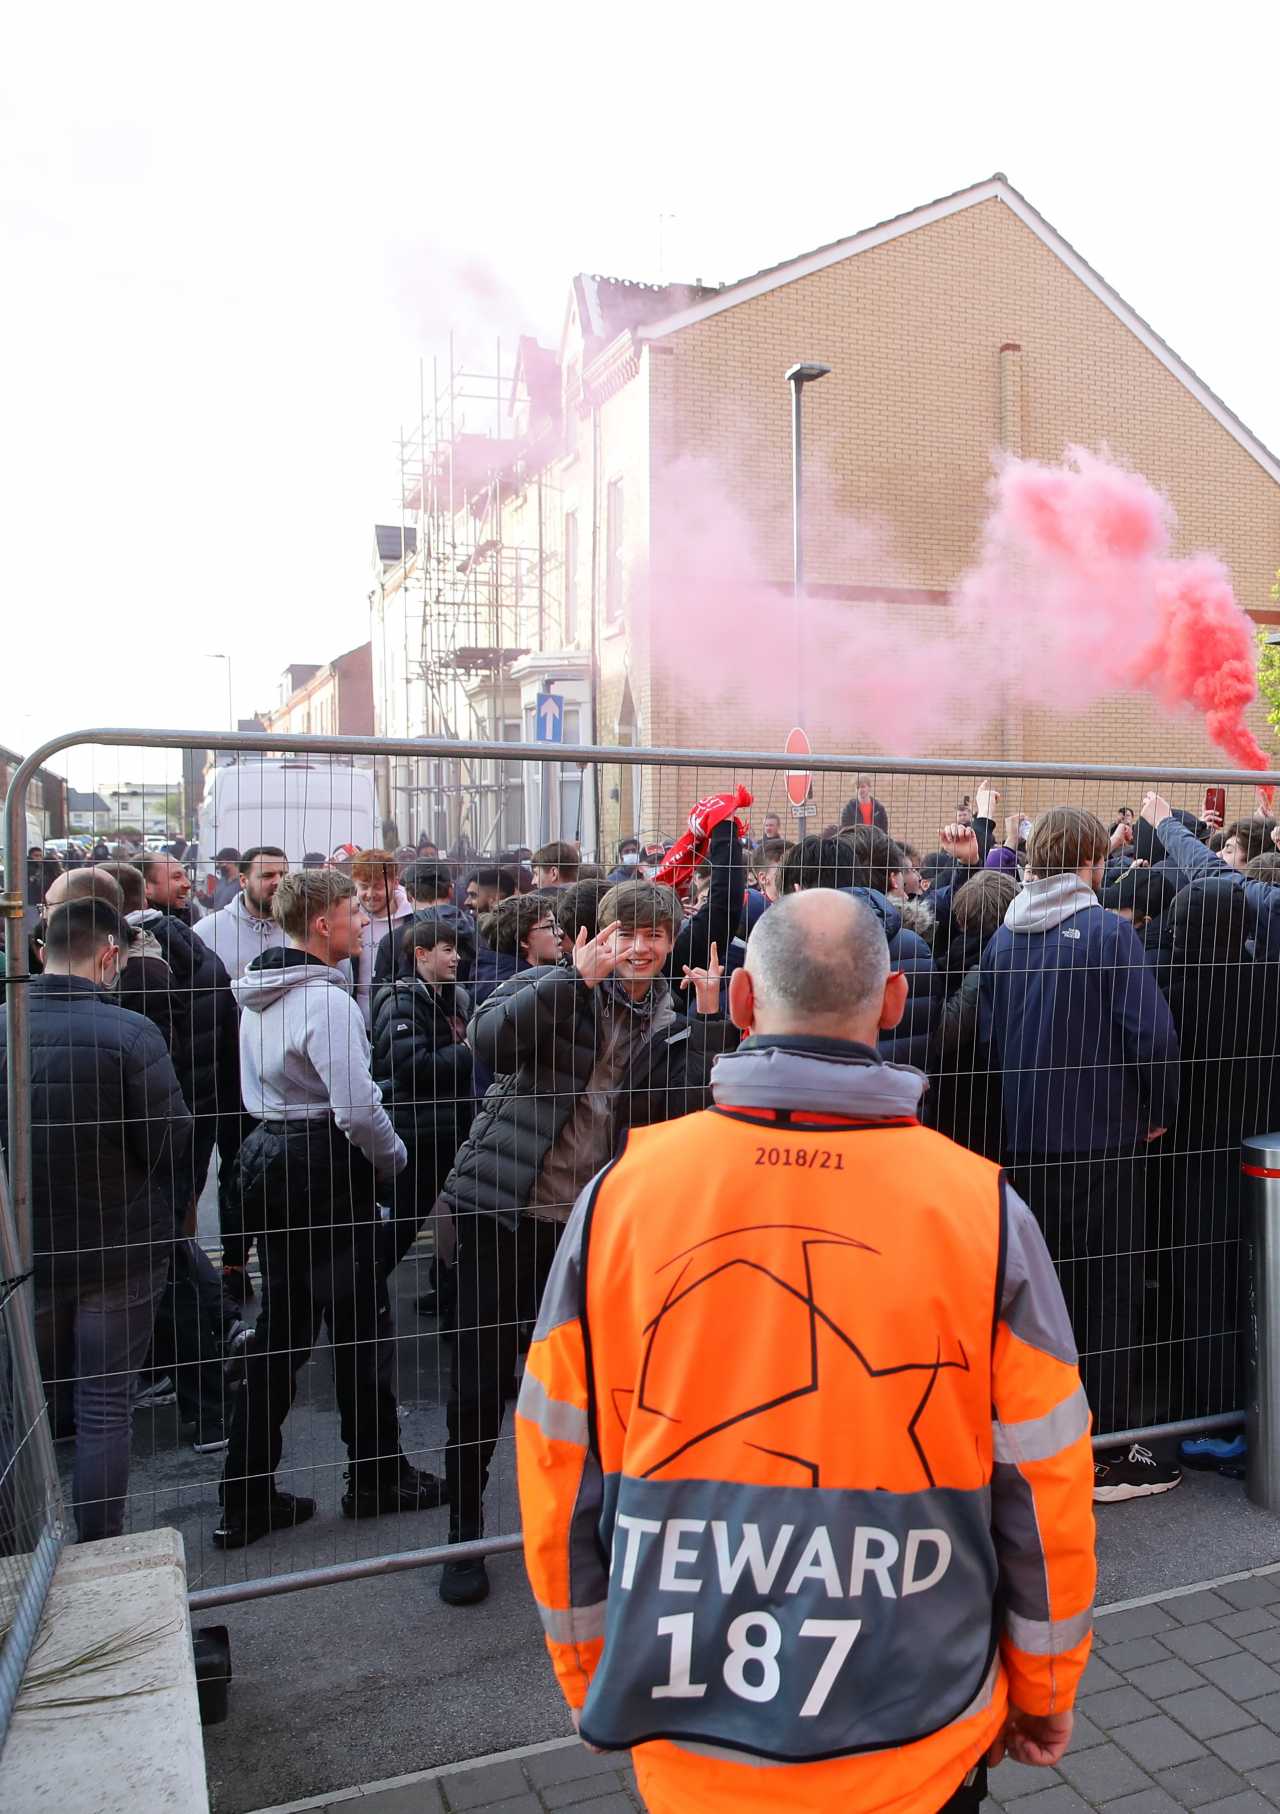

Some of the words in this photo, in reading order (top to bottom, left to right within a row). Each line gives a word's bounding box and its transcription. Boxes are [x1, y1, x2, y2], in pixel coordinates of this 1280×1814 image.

[755, 1147, 845, 1170] 2018/21
[609, 1512, 953, 1599] TEWARD
[651, 1611, 862, 1717] 187
